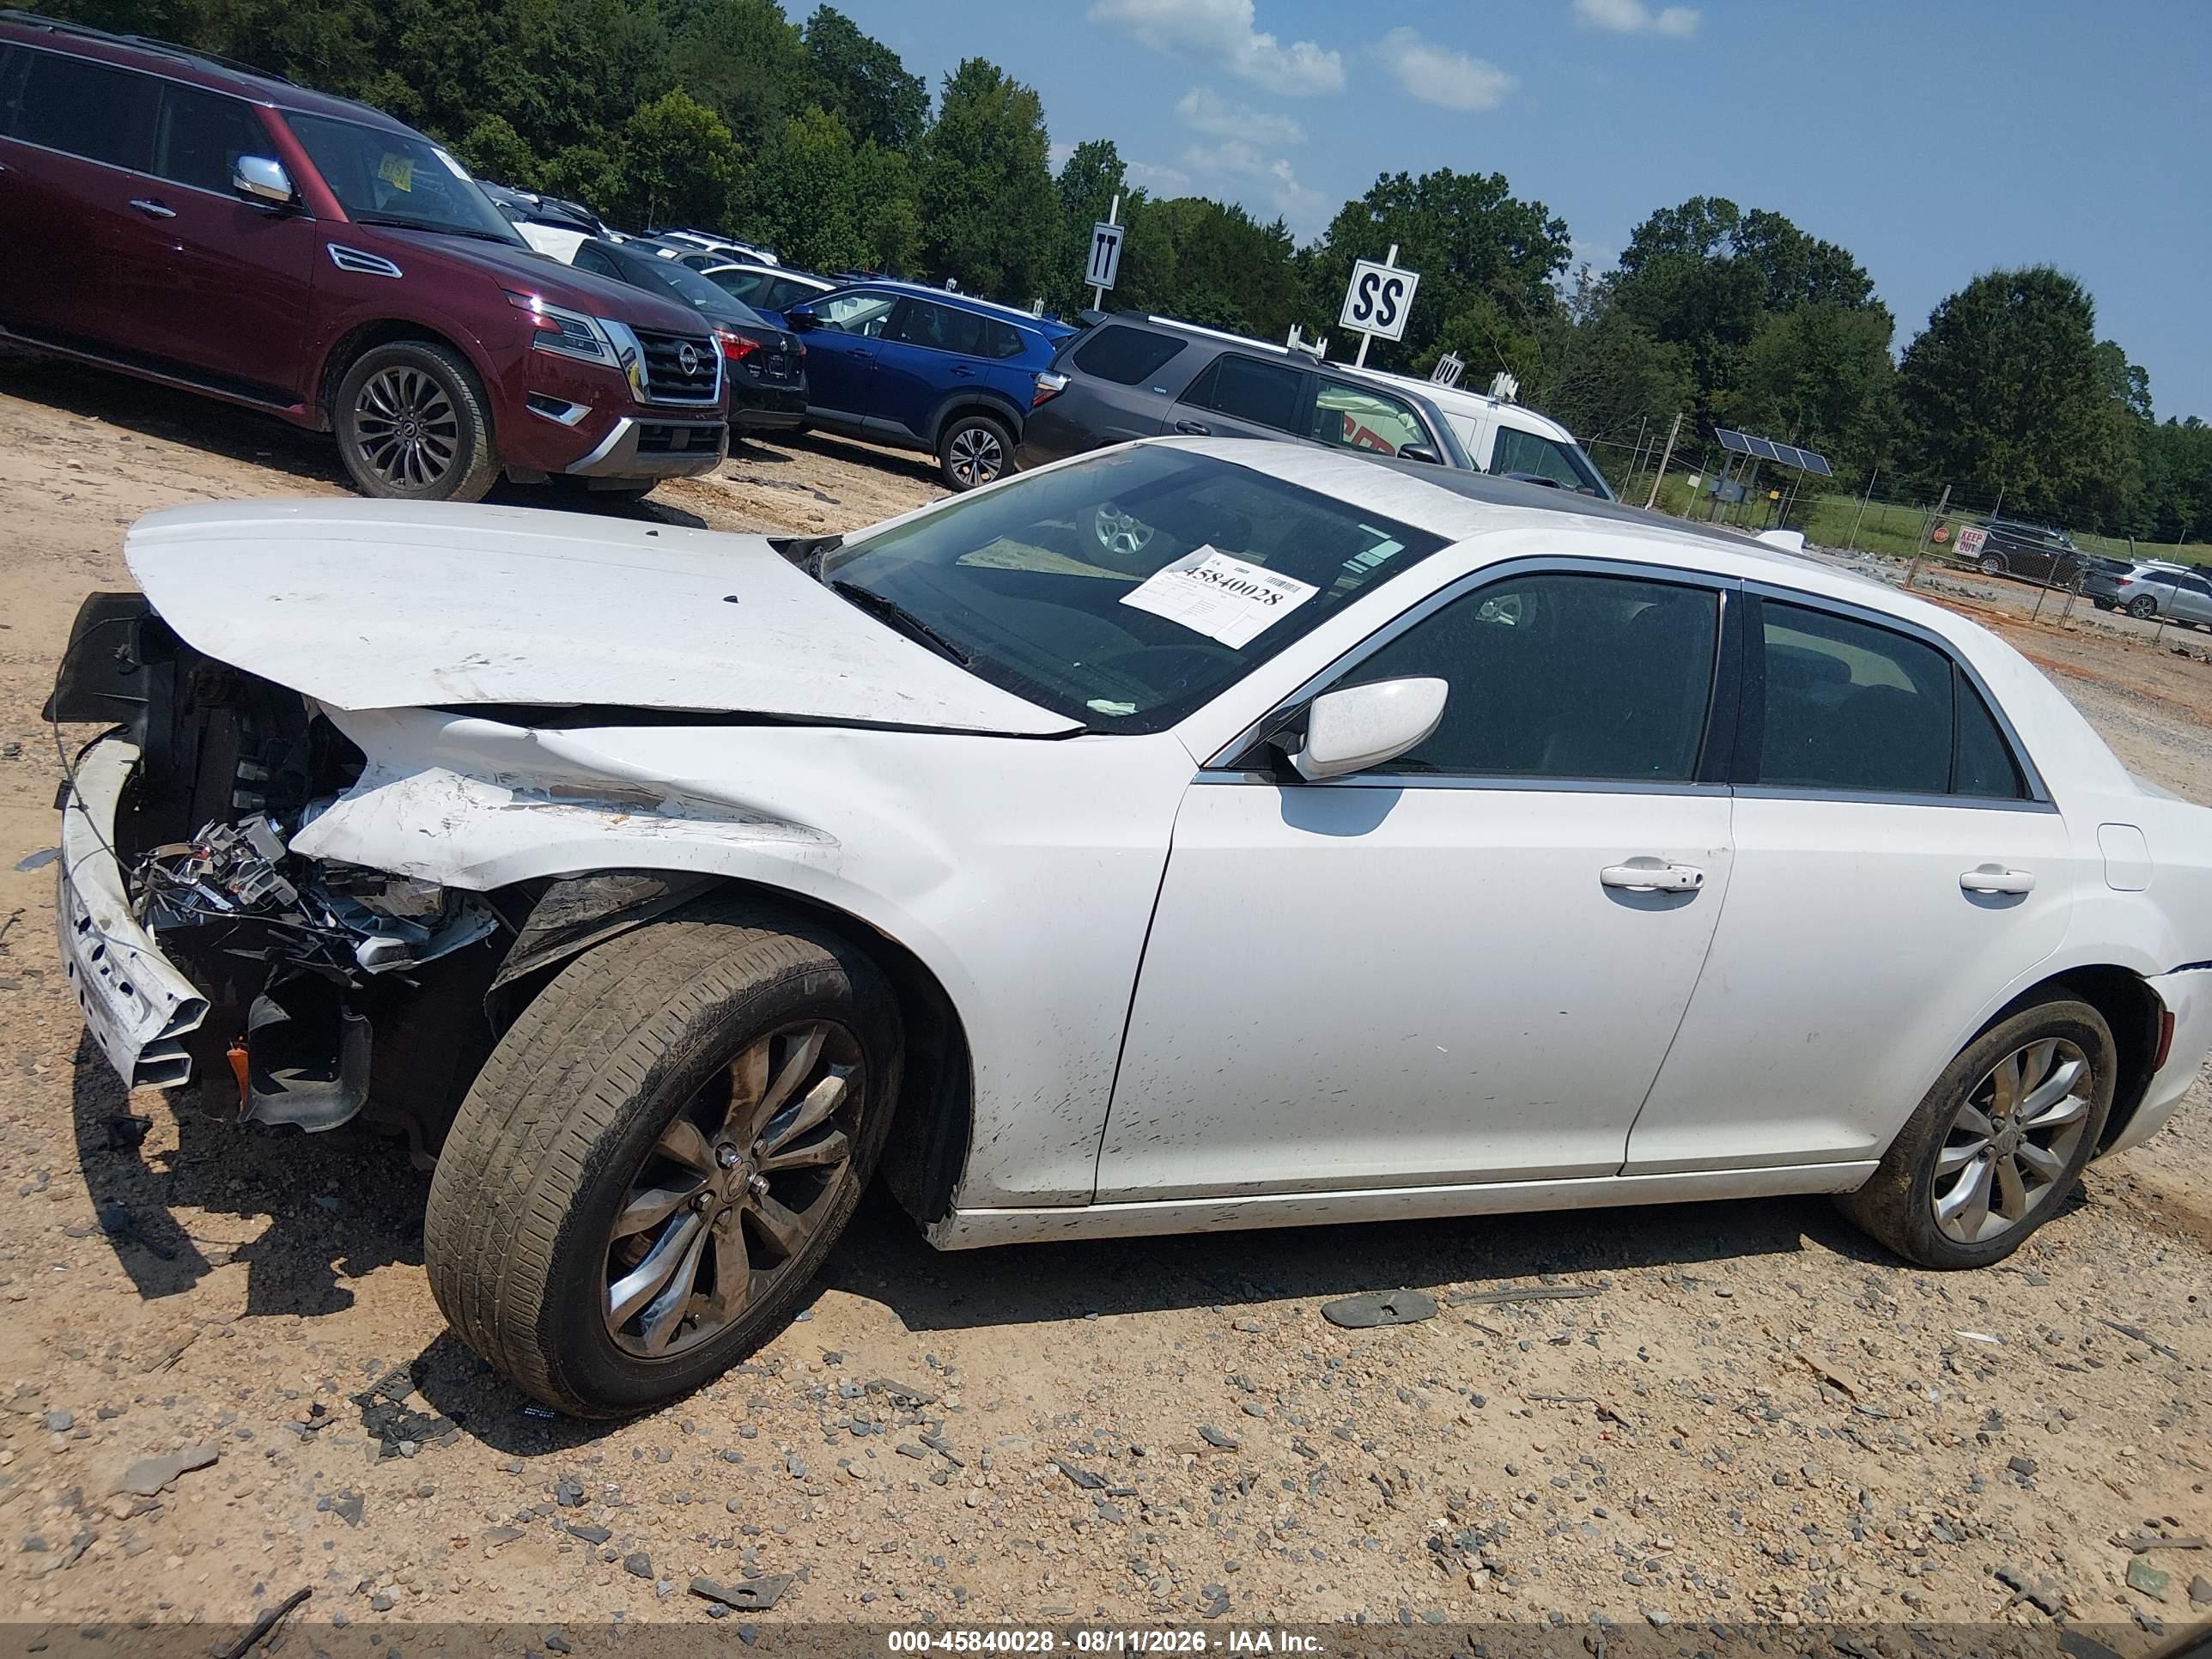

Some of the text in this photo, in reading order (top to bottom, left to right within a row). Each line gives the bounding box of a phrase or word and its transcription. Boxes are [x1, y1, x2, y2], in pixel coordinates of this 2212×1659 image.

[1092, 233, 1117, 279] TT
[1352, 272, 1404, 327] SS
[1435, 359, 1459, 385] UU
[1960, 542, 1977, 553] OUT
[1961, 530, 1983, 544] KEEP
[1182, 566, 1285, 606] 45840028
